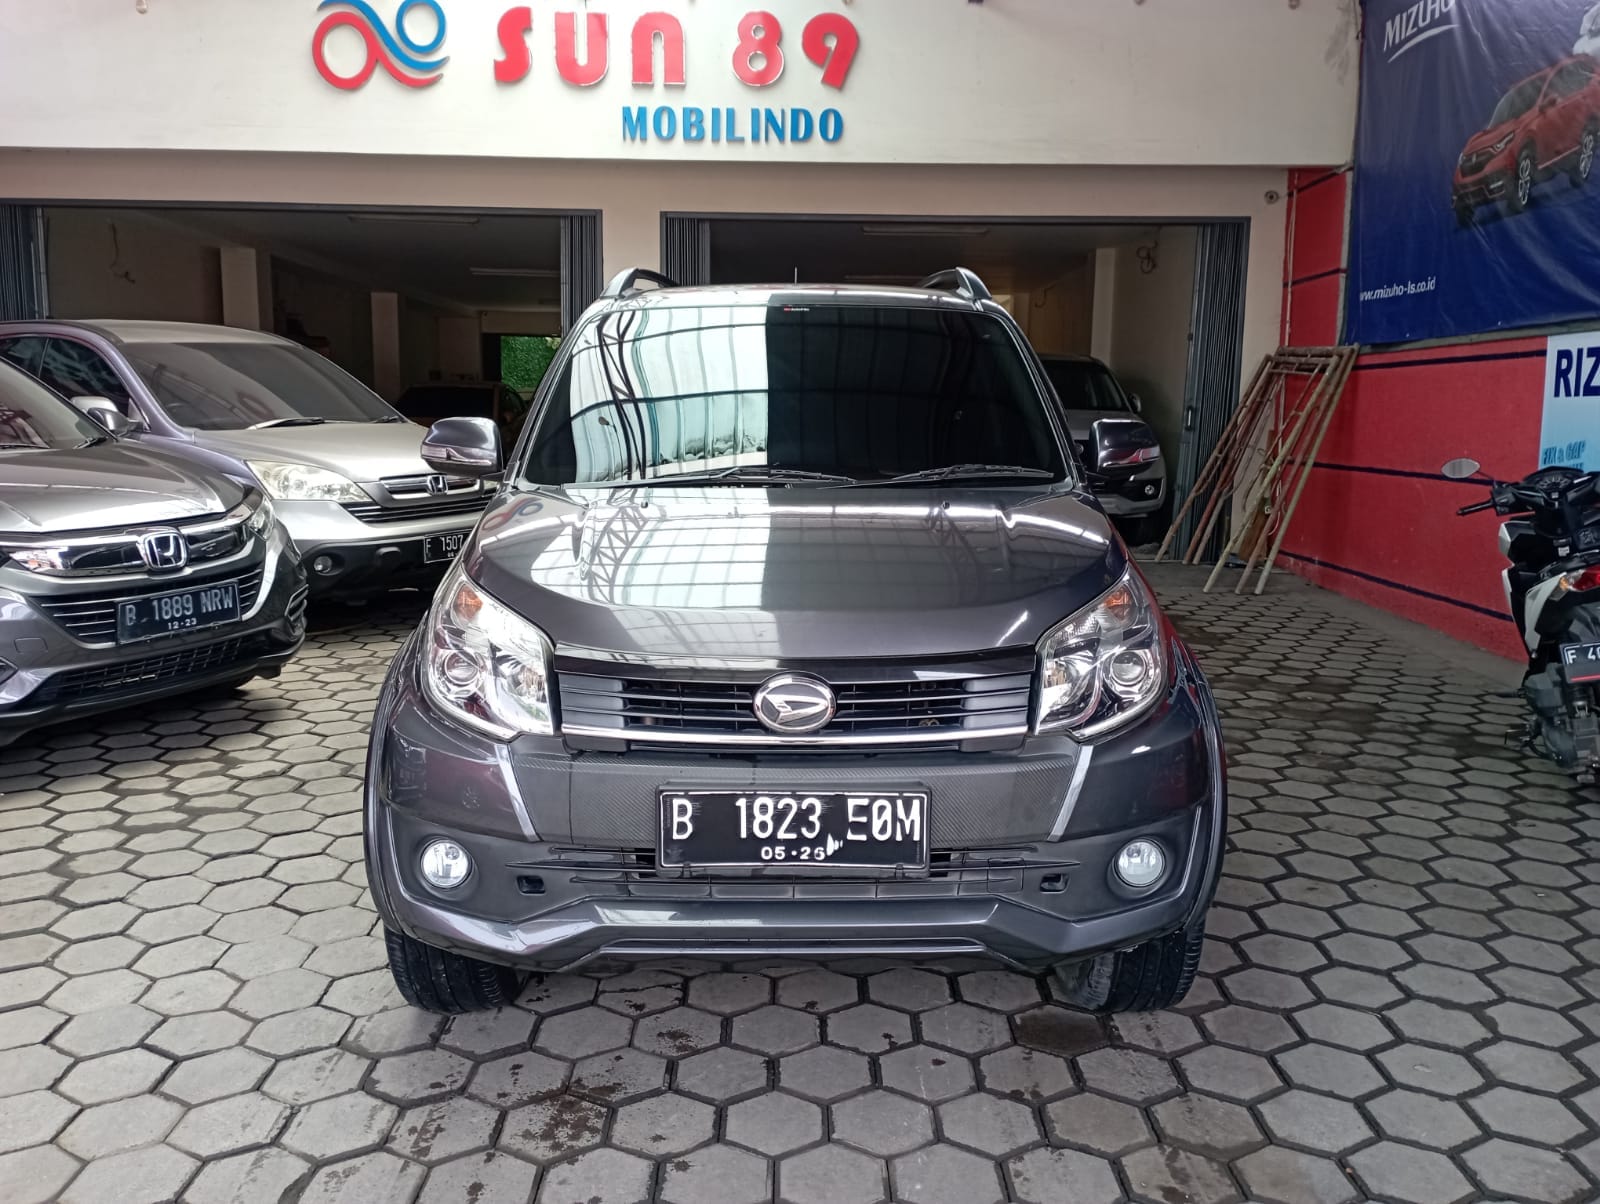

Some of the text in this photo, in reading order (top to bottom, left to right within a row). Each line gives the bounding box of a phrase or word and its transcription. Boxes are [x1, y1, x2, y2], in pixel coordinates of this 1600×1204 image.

[494, 6, 860, 91] SUN 89
[621, 106, 844, 143] MOBILINDO
[1553, 346, 1600, 398] RIZ
[425, 538, 432, 554] F
[125, 586, 233, 626] B 1889 NRW
[1567, 649, 1577, 664] F
[672, 798, 693, 840] B
[735, 797, 822, 839] 1823
